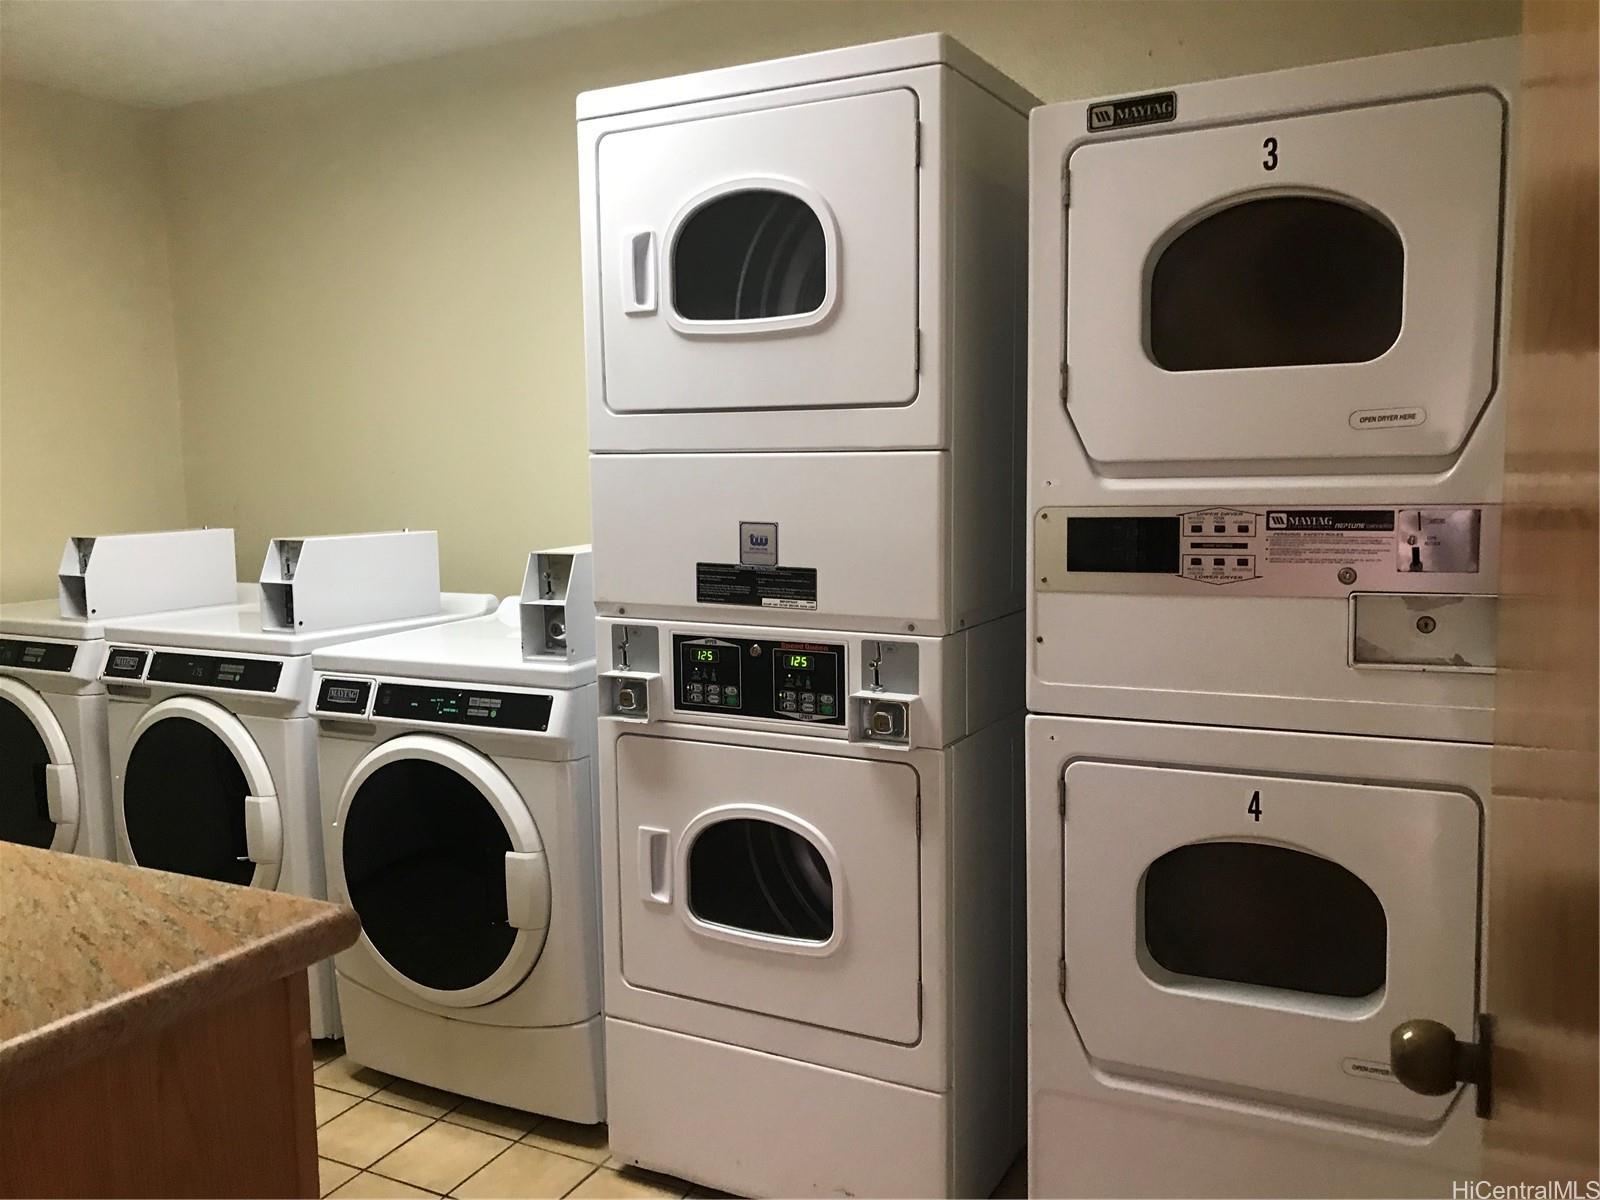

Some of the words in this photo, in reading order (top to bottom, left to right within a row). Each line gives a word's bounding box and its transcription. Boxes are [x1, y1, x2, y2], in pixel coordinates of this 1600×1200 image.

[1116, 102, 1172, 119] MAYTAG
[1263, 137, 1278, 171] 3
[1377, 414, 1399, 422] DRYER
[1289, 516, 1332, 526] MAYTAG
[697, 650, 713, 661] 125
[790, 656, 807, 667] 125
[1248, 790, 1262, 822] 4
